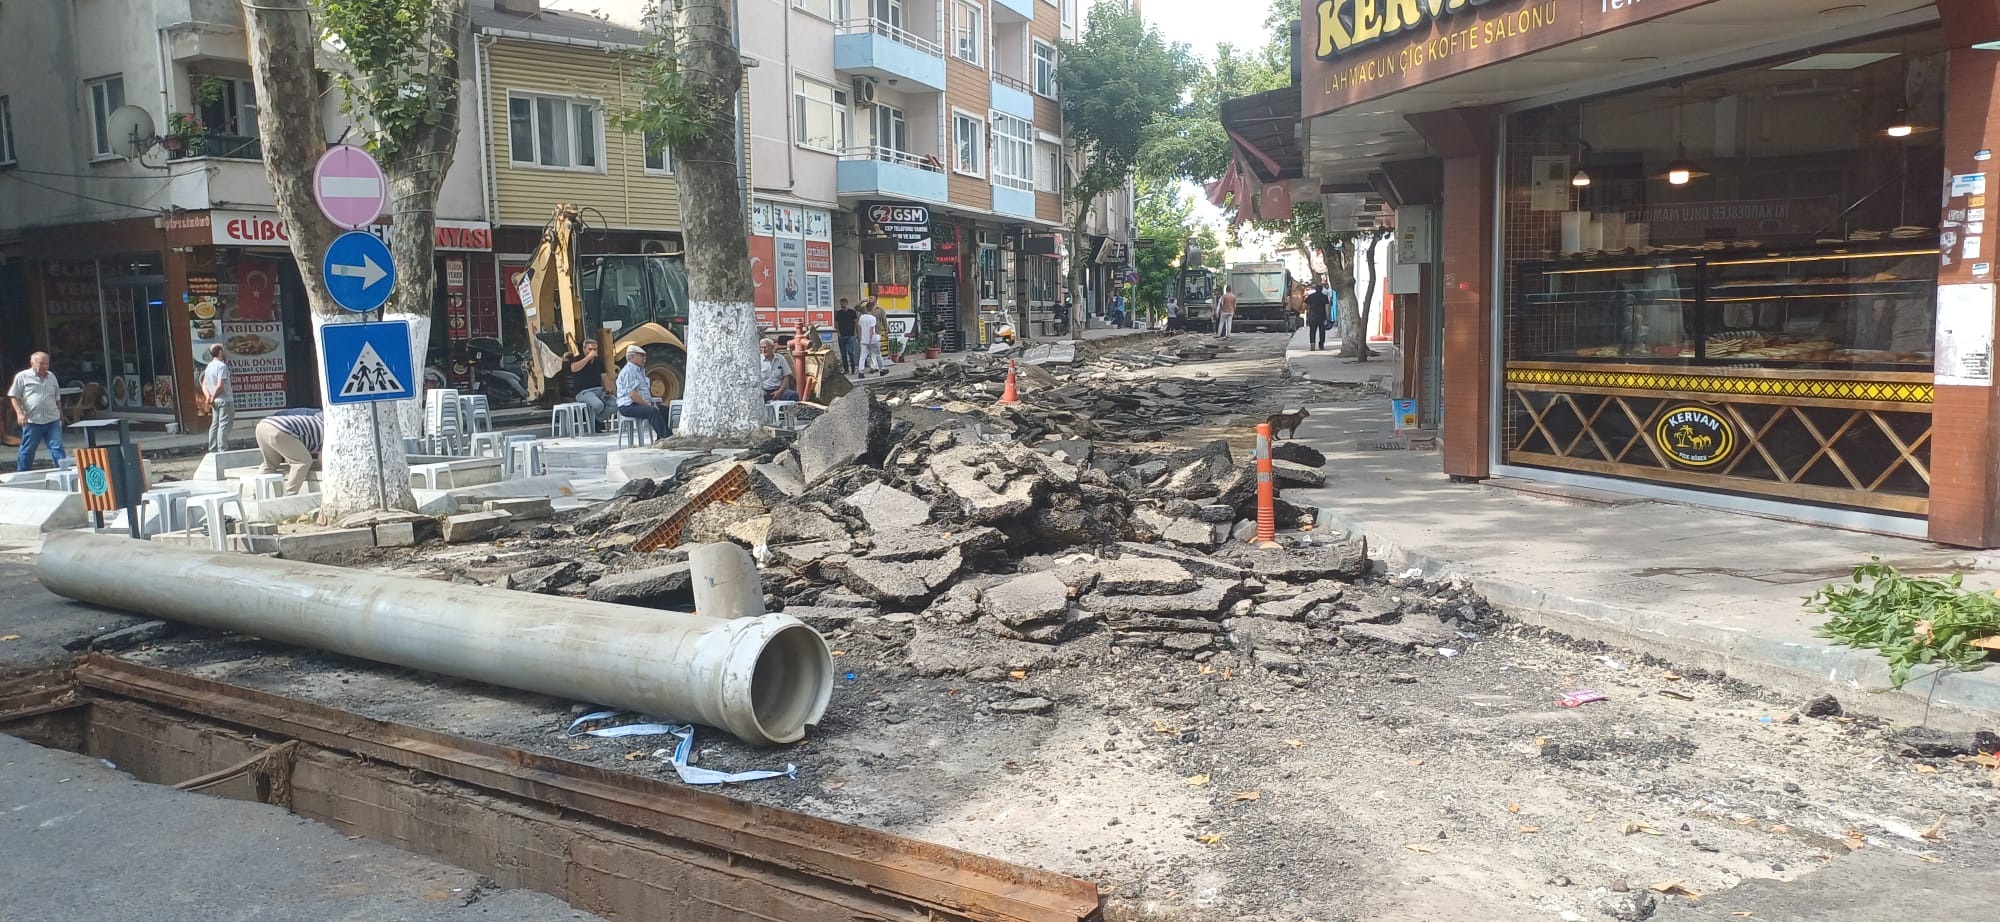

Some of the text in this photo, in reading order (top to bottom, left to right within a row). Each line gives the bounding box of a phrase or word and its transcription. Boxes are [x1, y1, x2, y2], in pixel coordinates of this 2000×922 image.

[1325, 55, 1396, 95] LAHMACUN
[1484, 0, 1557, 44] SALONU
[893, 208, 923, 222] GSM
[434, 227, 492, 249] NYASI
[888, 321, 905, 333] GSM
[252, 358, 283, 367] DÖNER
[1668, 411, 1720, 431] KERVAN
